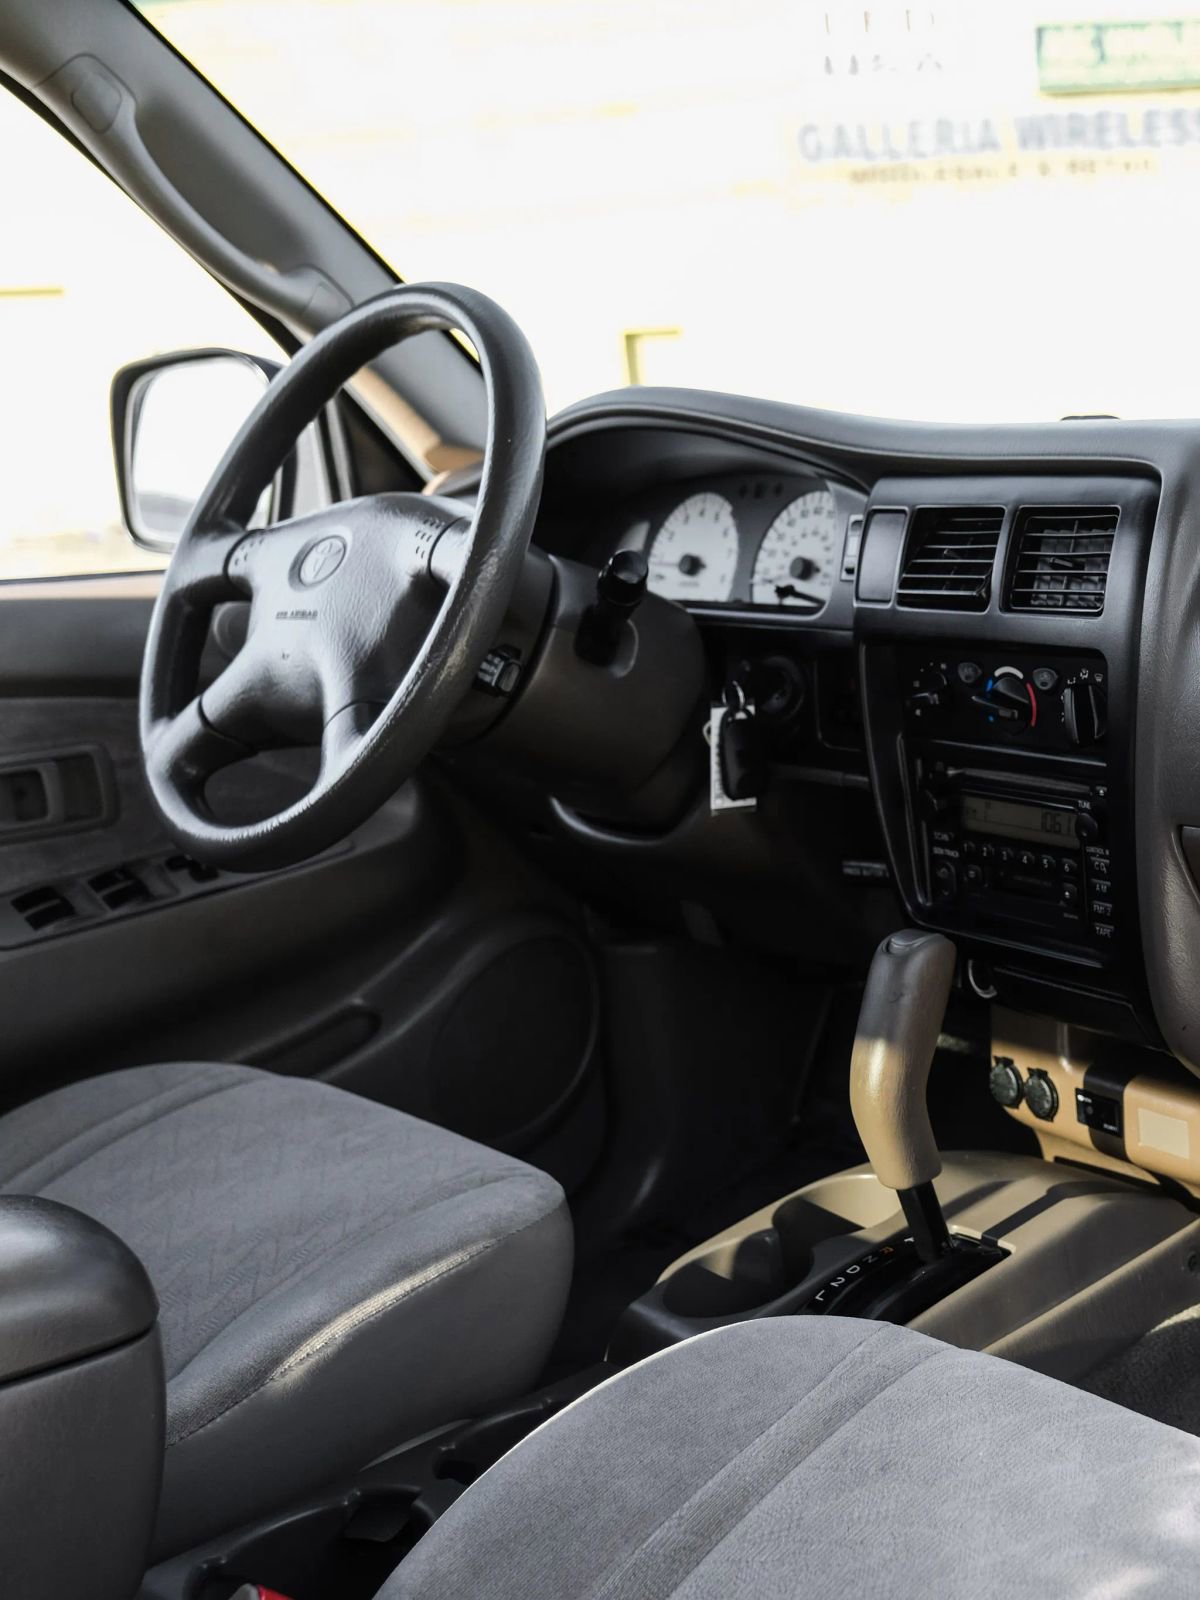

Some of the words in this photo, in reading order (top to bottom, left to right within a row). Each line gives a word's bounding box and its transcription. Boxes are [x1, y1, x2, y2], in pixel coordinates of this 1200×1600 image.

[797, 117, 1002, 162] GALLERIA
[829, 1276, 846, 1288] 2
[845, 1264, 861, 1274] D
